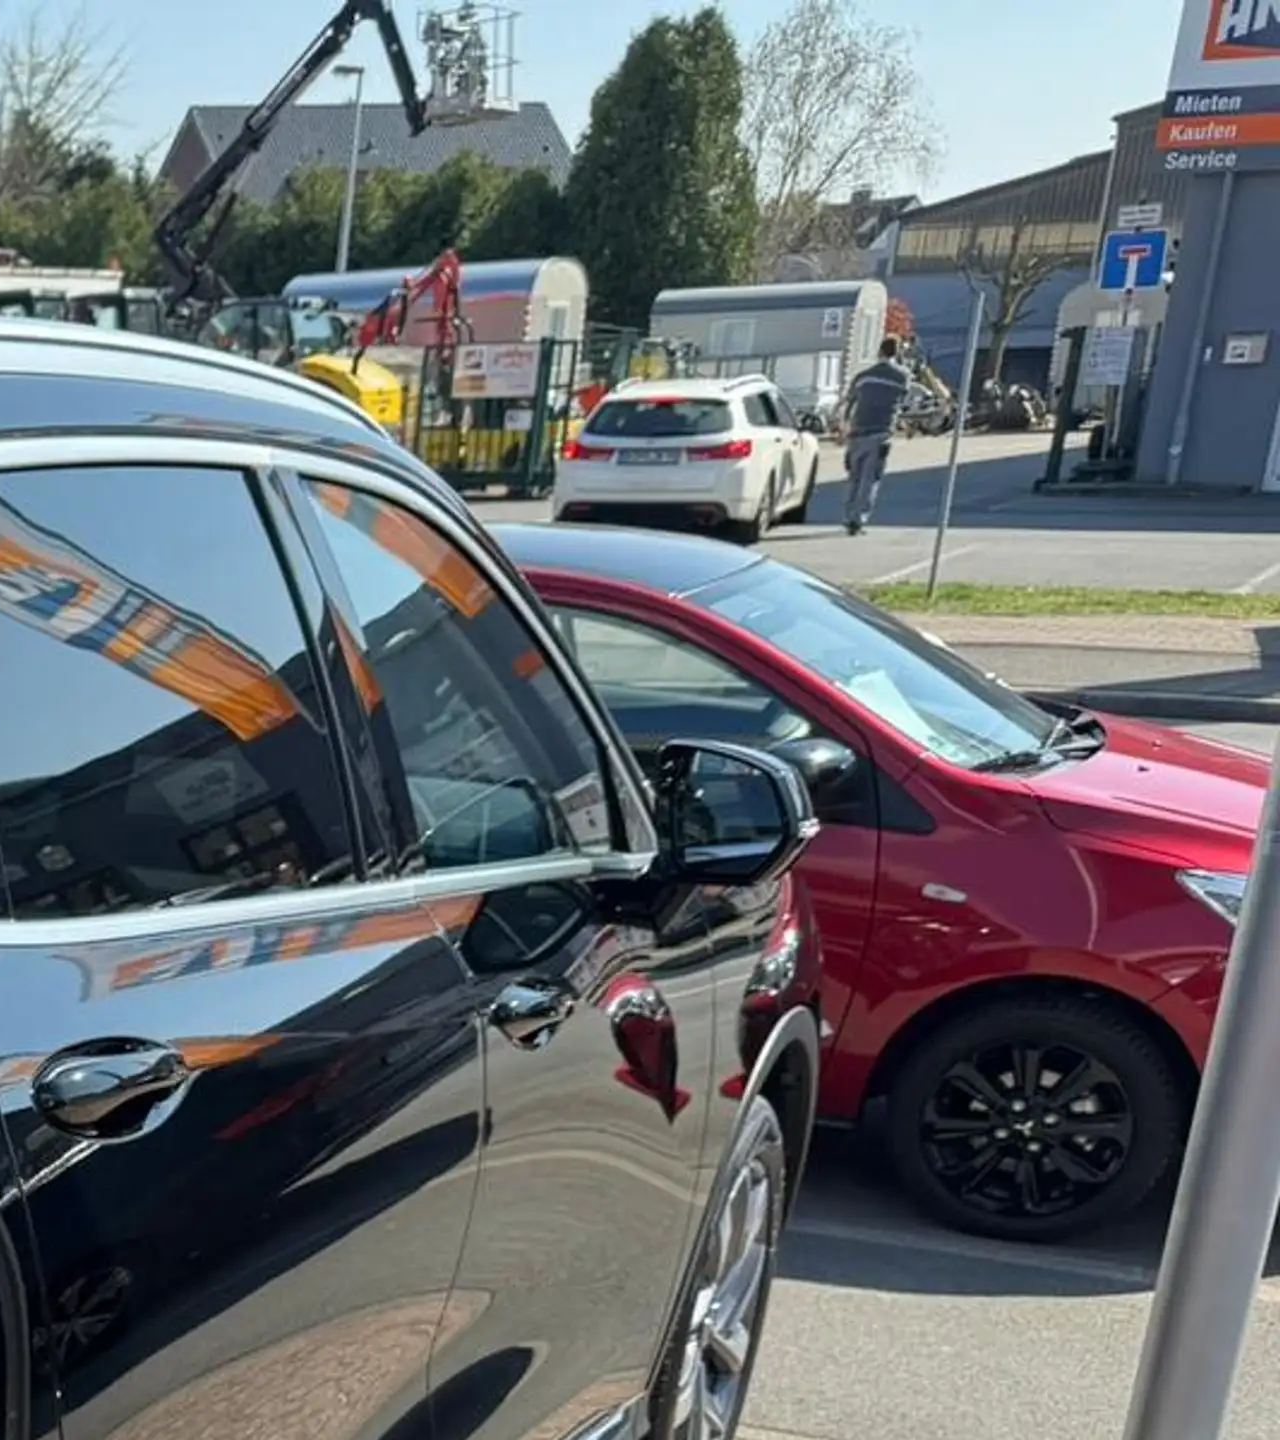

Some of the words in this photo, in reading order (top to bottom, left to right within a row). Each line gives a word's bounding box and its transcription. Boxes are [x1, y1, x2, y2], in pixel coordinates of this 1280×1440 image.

[1174, 94, 1242, 113] Mieten
[1169, 121, 1238, 141] Kaufen
[1164, 149, 1237, 169] Service
